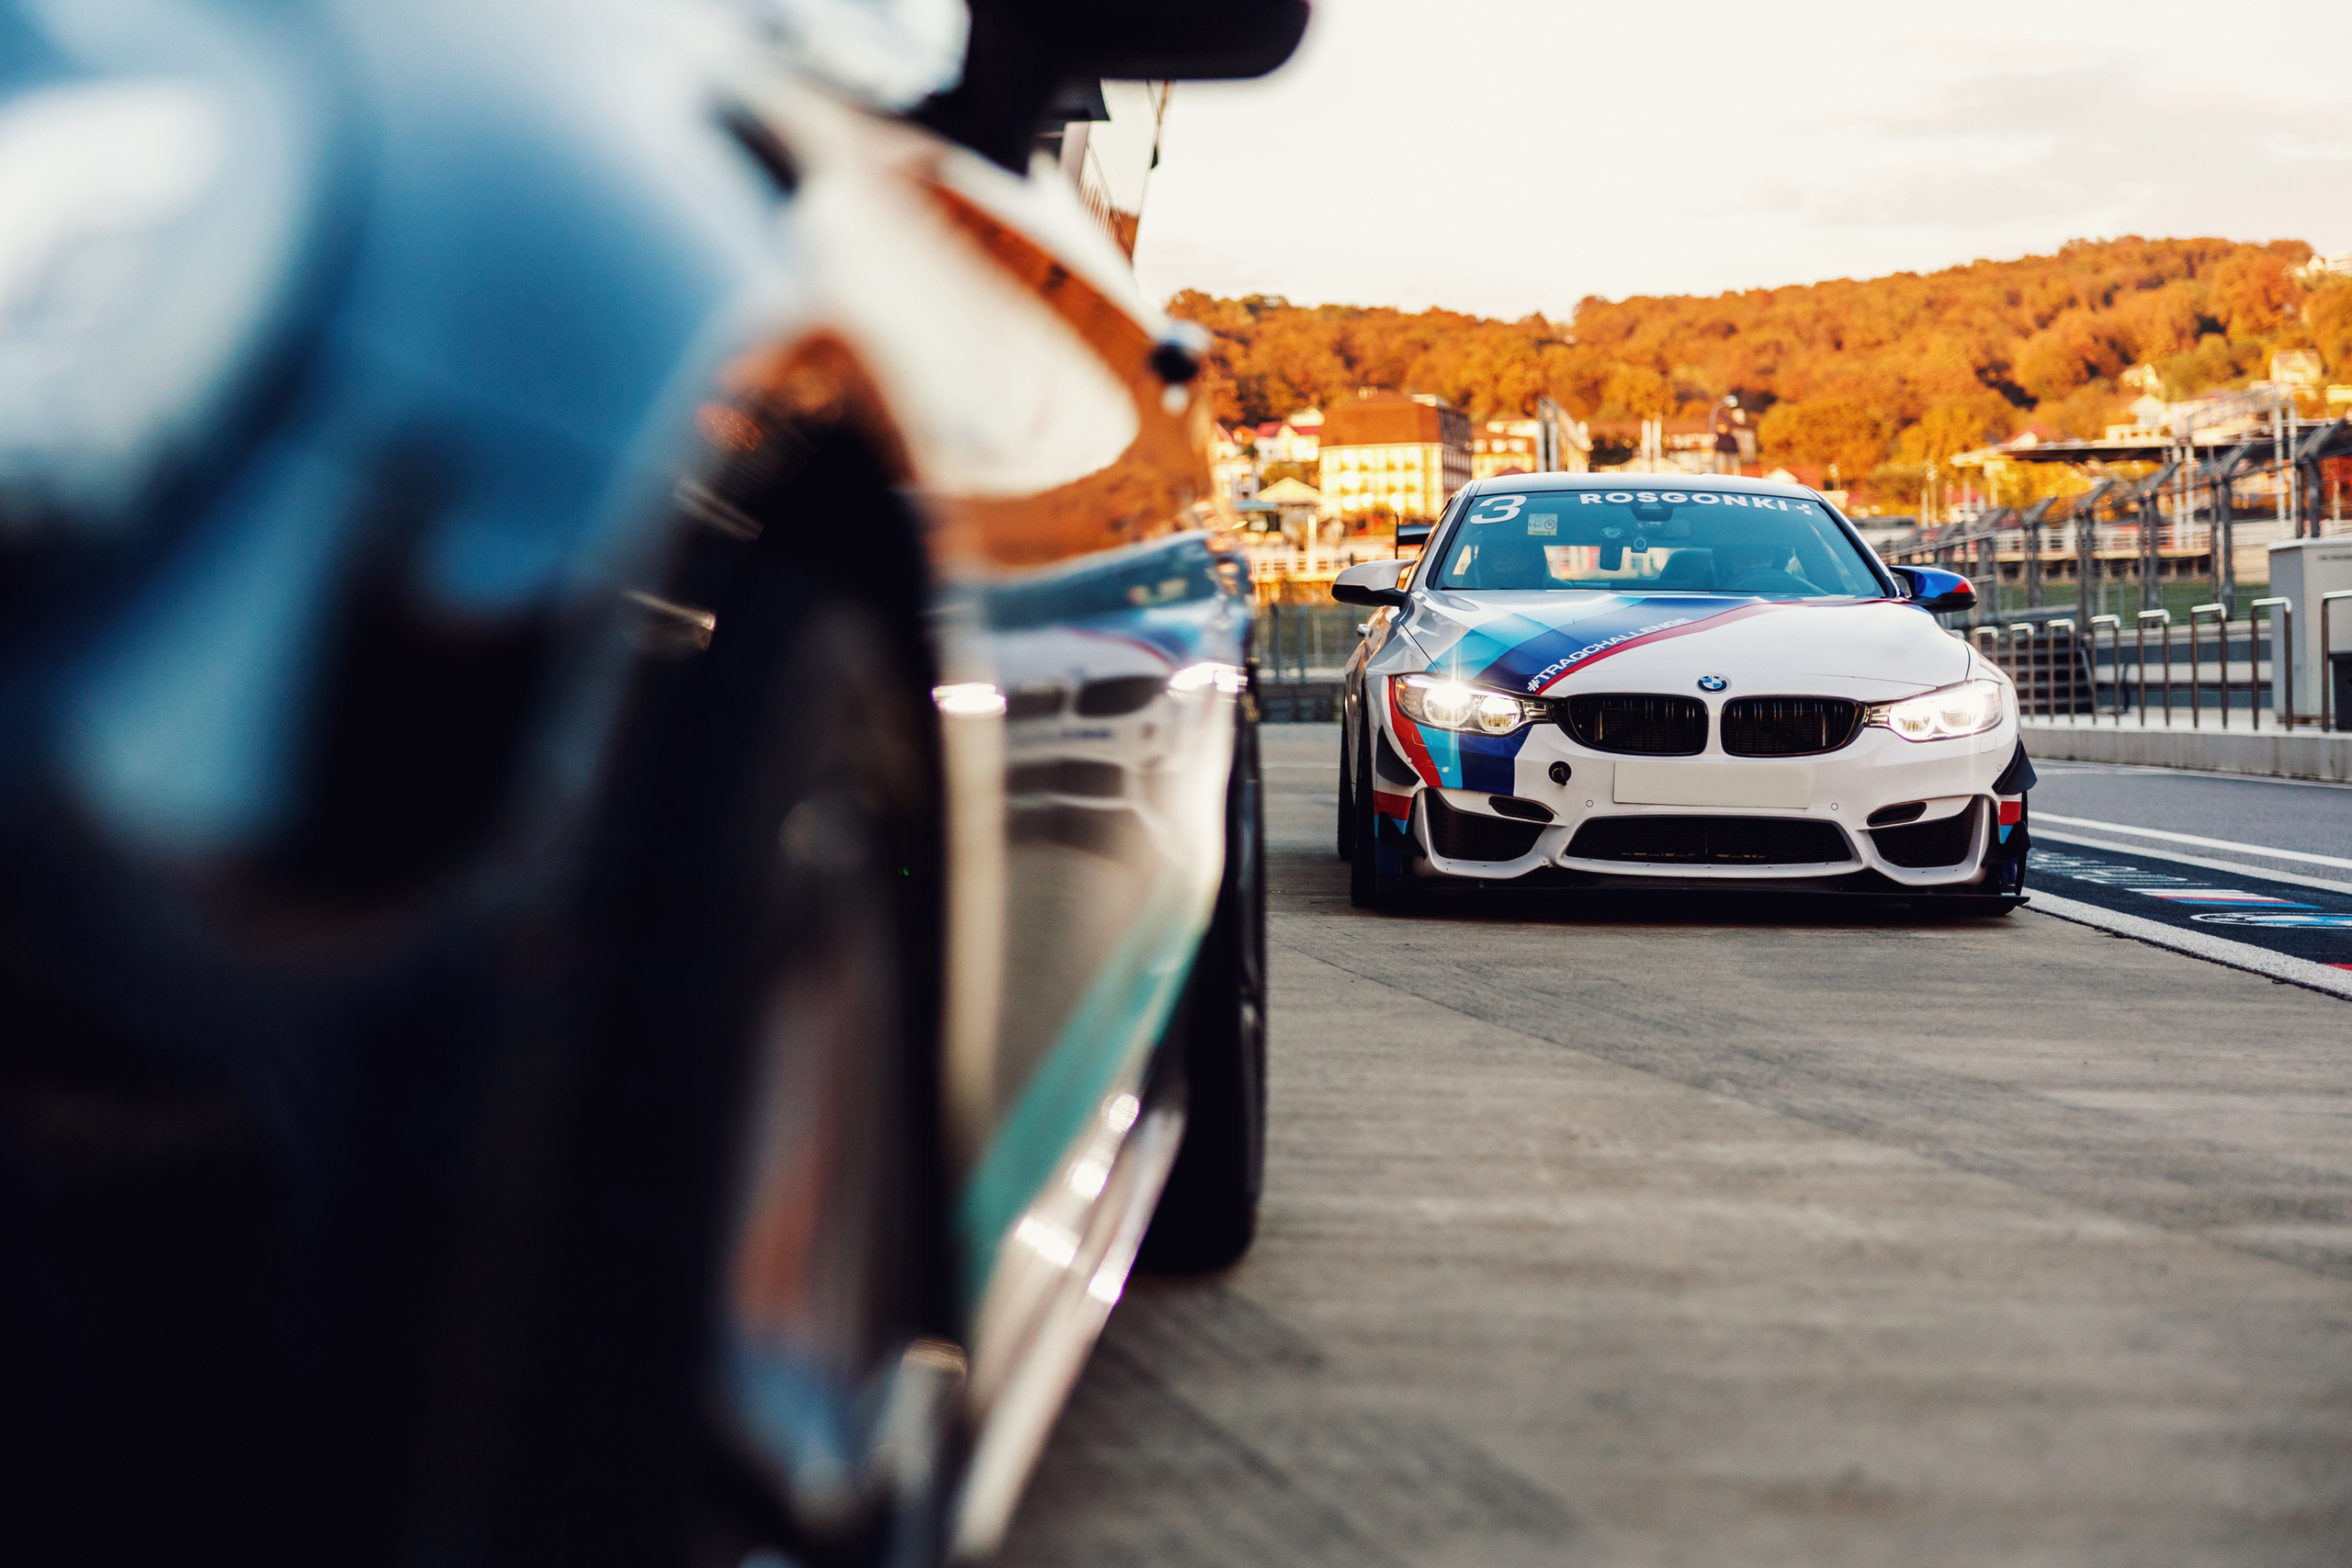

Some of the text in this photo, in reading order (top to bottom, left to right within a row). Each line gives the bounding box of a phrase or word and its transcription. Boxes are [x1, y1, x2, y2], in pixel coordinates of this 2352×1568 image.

[1470, 495, 1527, 524] 3
[1579, 492, 1788, 511] ROSGONKI
[1527, 618, 1693, 692] #TRAQCHALLENGE
